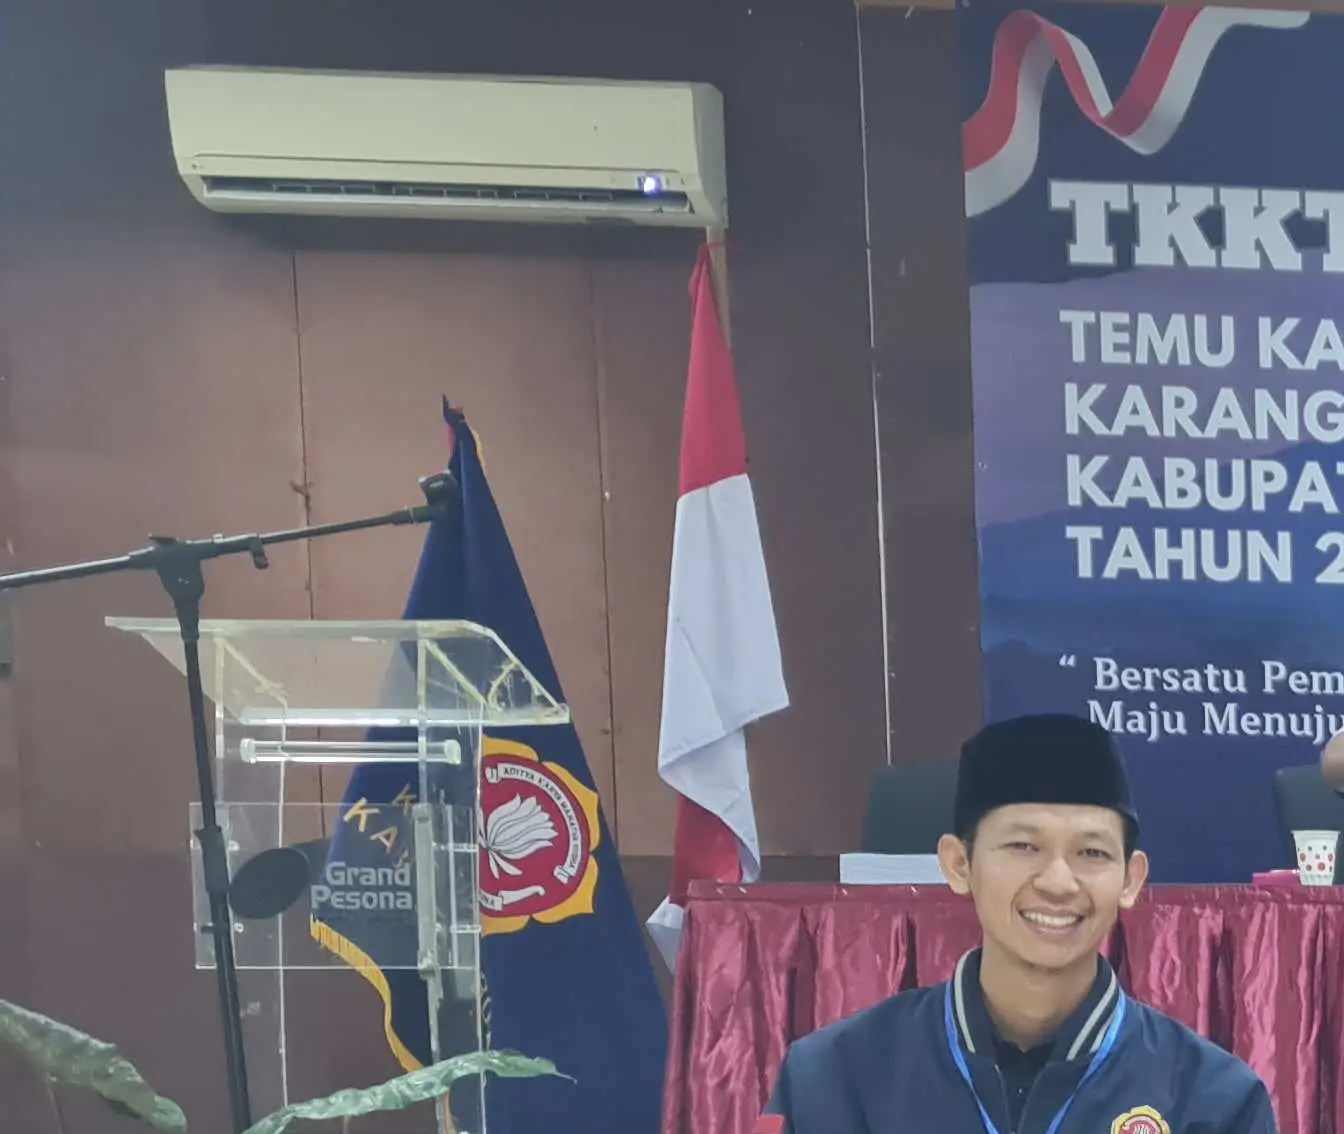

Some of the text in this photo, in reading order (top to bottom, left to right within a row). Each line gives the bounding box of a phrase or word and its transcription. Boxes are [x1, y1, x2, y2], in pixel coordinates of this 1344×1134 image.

[1059, 310, 1235, 367] TEMU
[1065, 525, 1293, 583] TAHUN
[1093, 656, 1248, 693] Bersatu
[1086, 699, 1188, 743] Maju
[325, 861, 411, 886] Grand
[310, 885, 413, 910] Pesona
